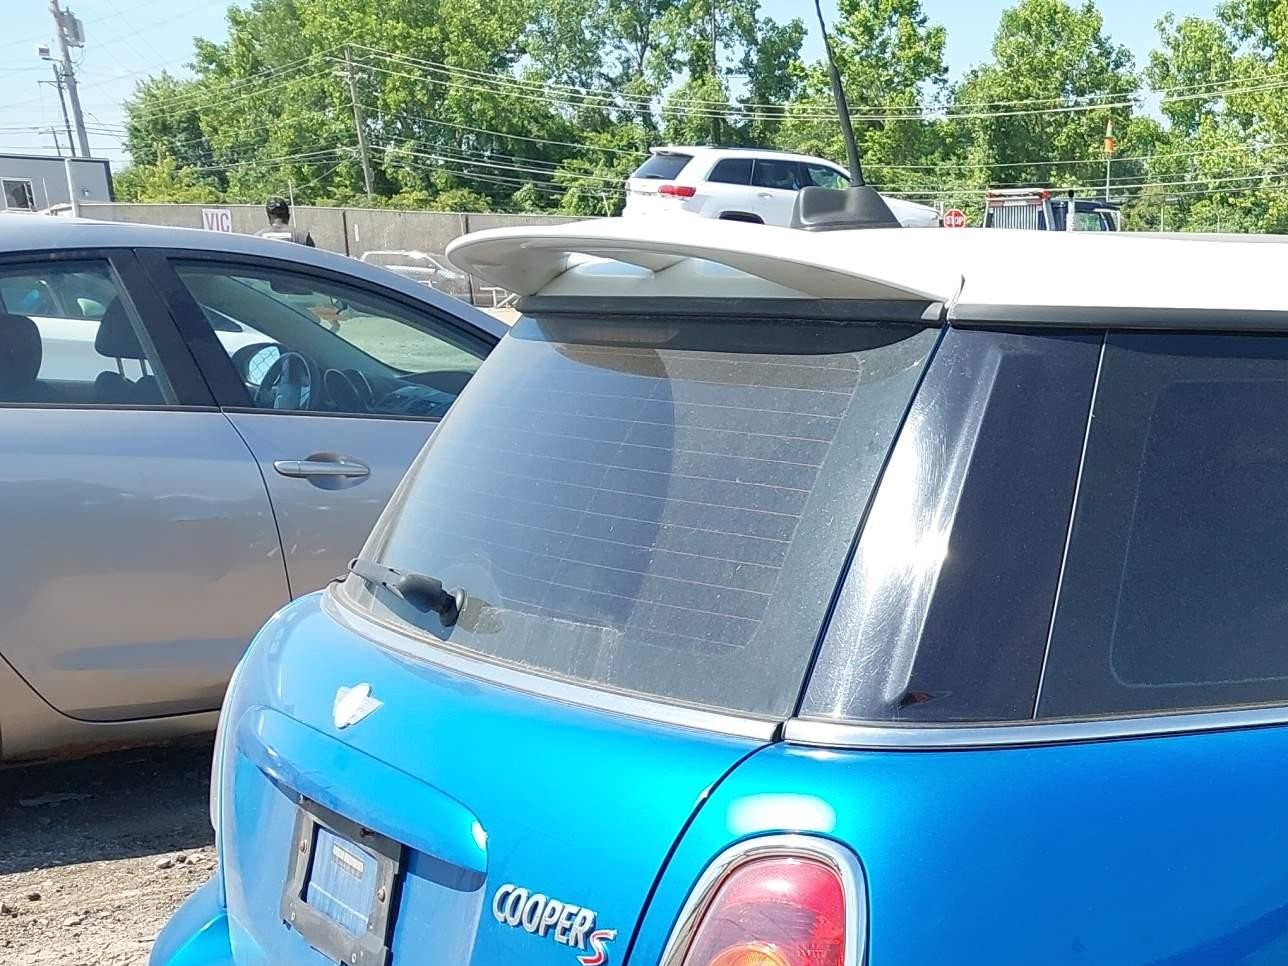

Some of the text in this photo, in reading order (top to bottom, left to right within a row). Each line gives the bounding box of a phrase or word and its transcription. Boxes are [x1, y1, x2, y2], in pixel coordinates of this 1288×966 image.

[204, 212, 230, 232] VIC
[945, 215, 964, 225] STOP
[492, 883, 597, 951] COOPER
